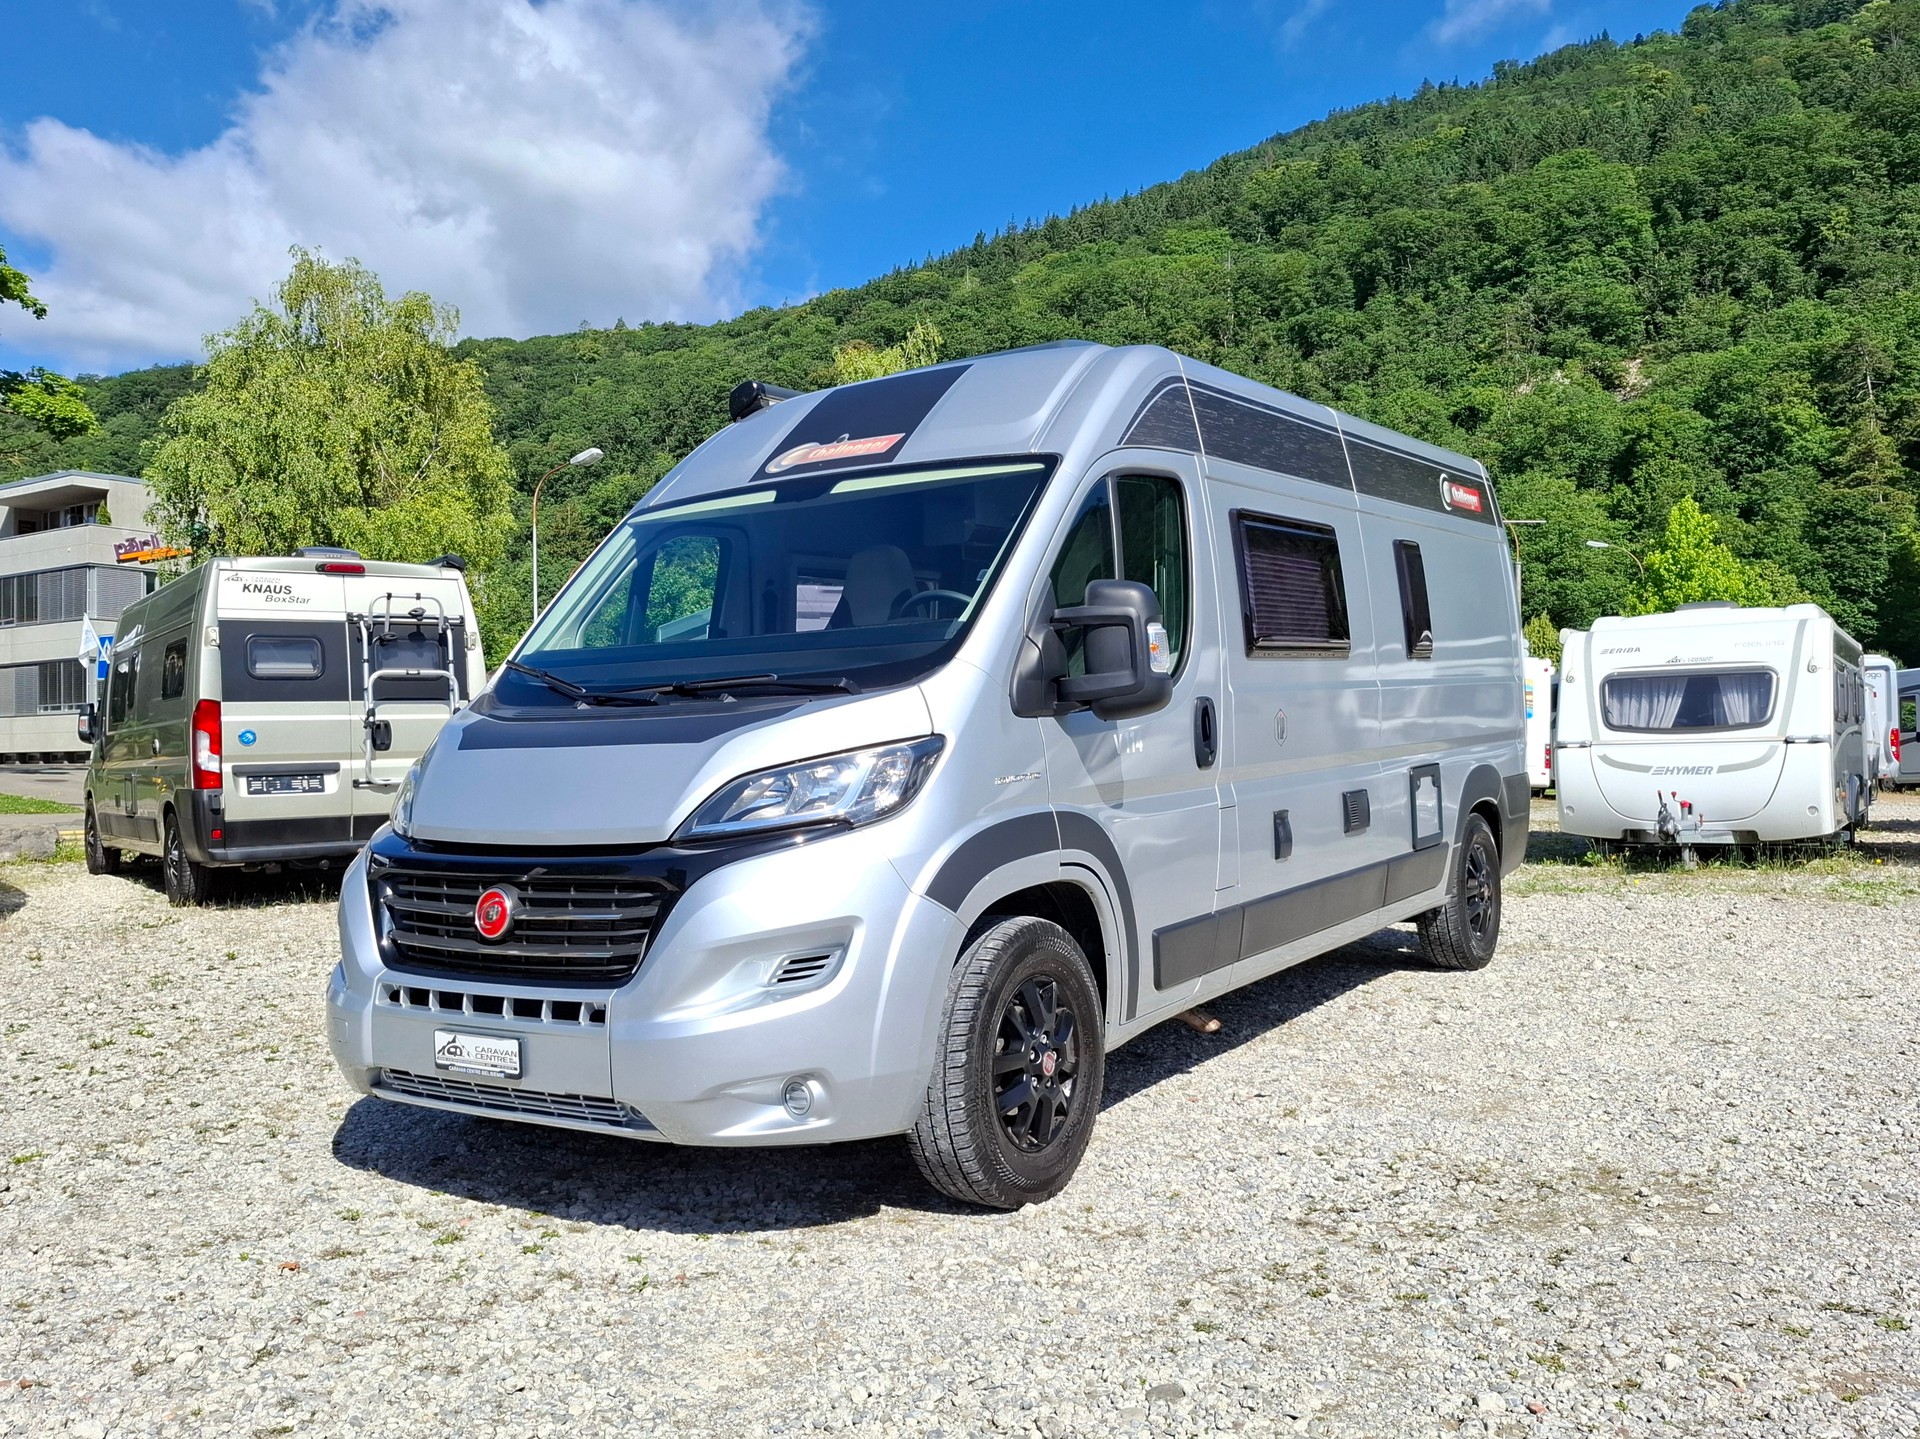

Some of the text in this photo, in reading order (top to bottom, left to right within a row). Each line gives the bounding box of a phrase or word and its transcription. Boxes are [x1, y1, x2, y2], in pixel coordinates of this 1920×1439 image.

[807, 439, 888, 459] Challenger
[1451, 486, 1478, 510] Challenger
[242, 583, 292, 595] KNAUS
[264, 594, 311, 604] BoxStar
[1608, 646, 1641, 655] ERIBA
[1663, 765, 1714, 776] HYMER
[474, 1045, 518, 1058] CARAVAN
[475, 1052, 509, 1064] CENTRE
